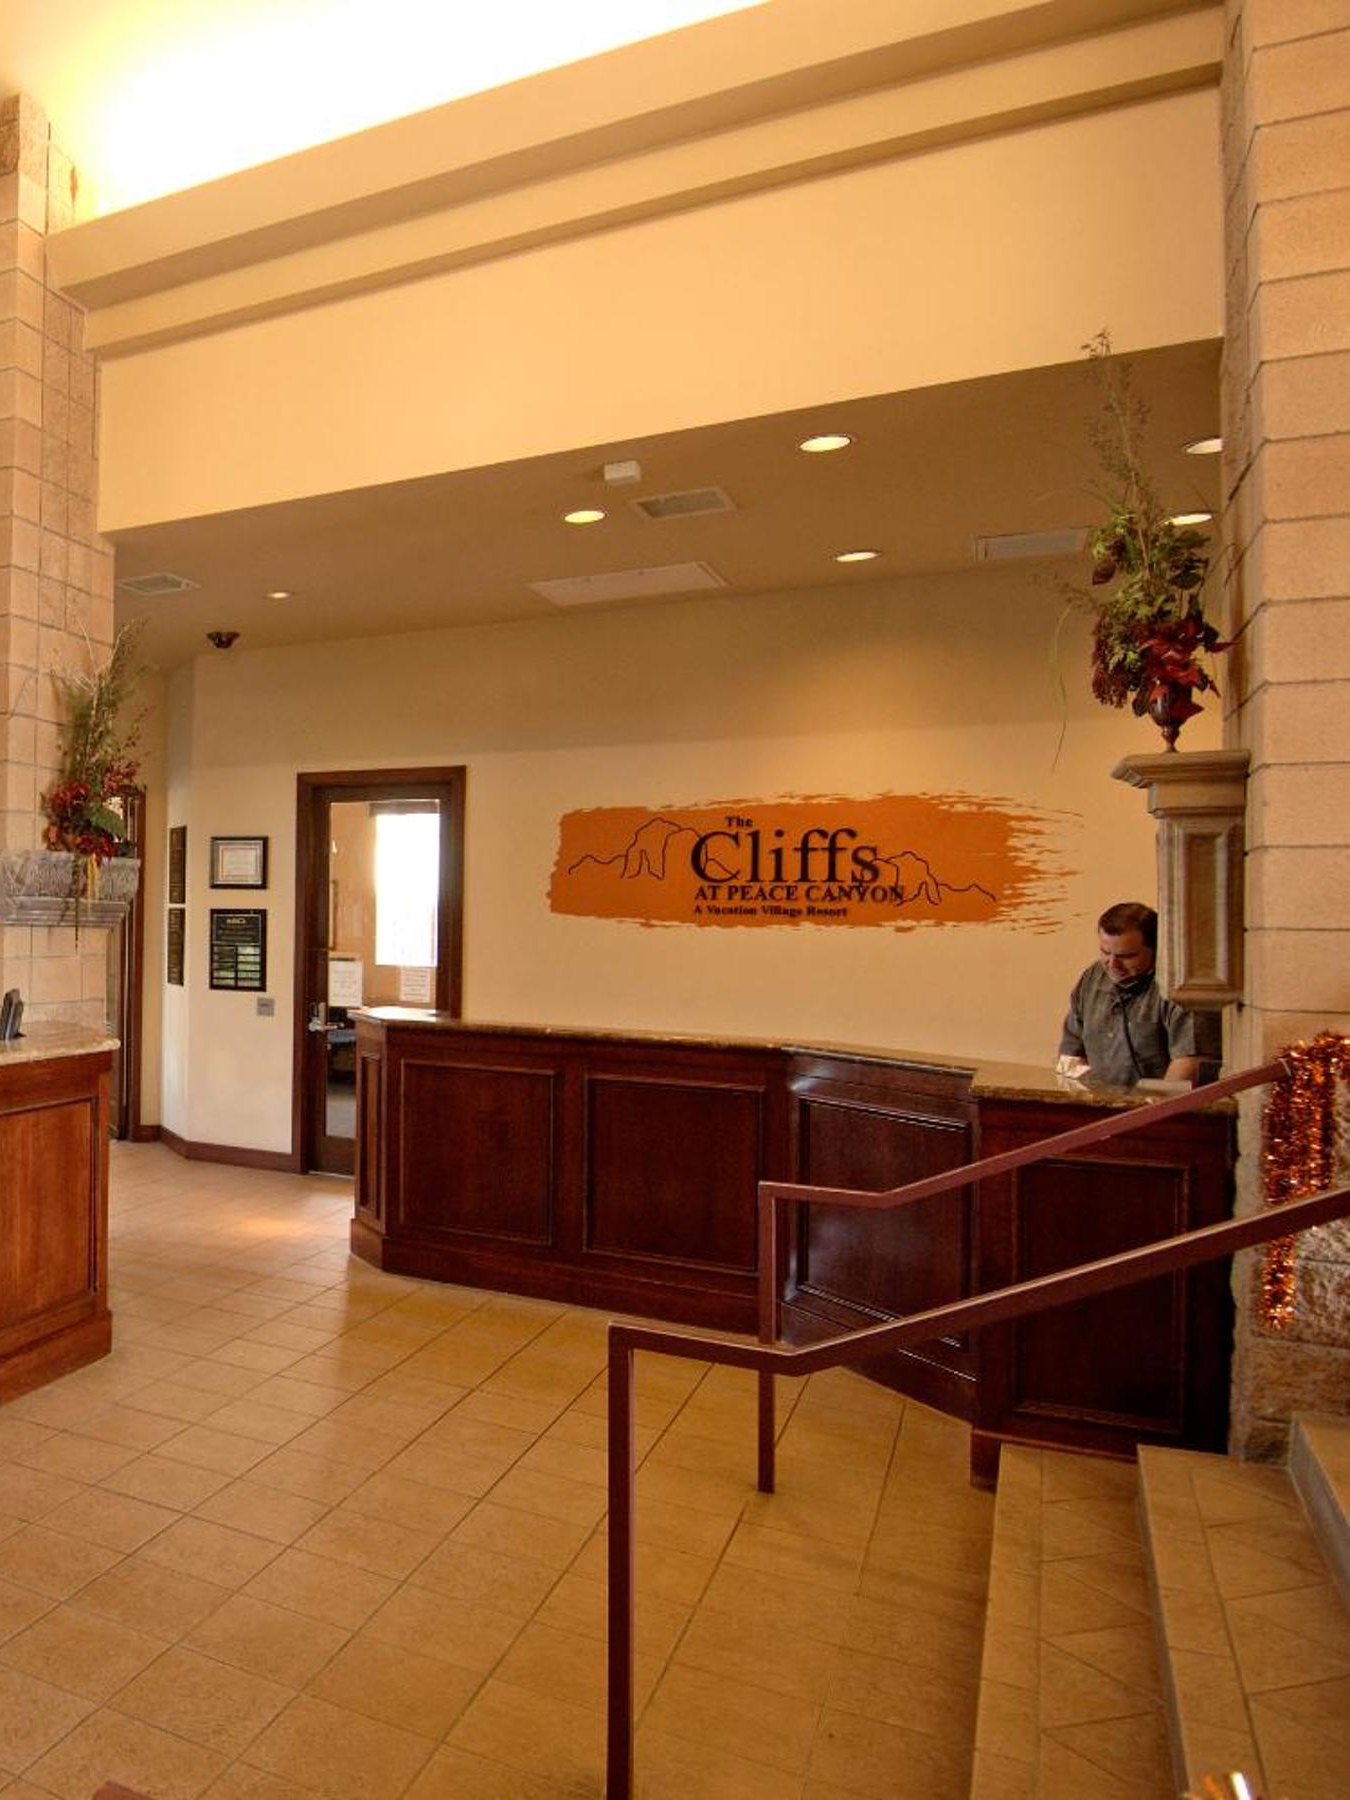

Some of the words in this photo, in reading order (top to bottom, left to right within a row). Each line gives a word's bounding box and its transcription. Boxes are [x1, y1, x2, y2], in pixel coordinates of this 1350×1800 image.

[725, 816, 753, 828] The
[690, 828, 880, 884] Cliffs
[694, 885, 720, 901] AT
[727, 885, 798, 901] PEACE
[805, 885, 905, 901] CANYON
[694, 905, 703, 915] A
[706, 904, 757, 916] Vacation
[761, 904, 803, 918] Village
[807, 905, 848, 917] Resort
